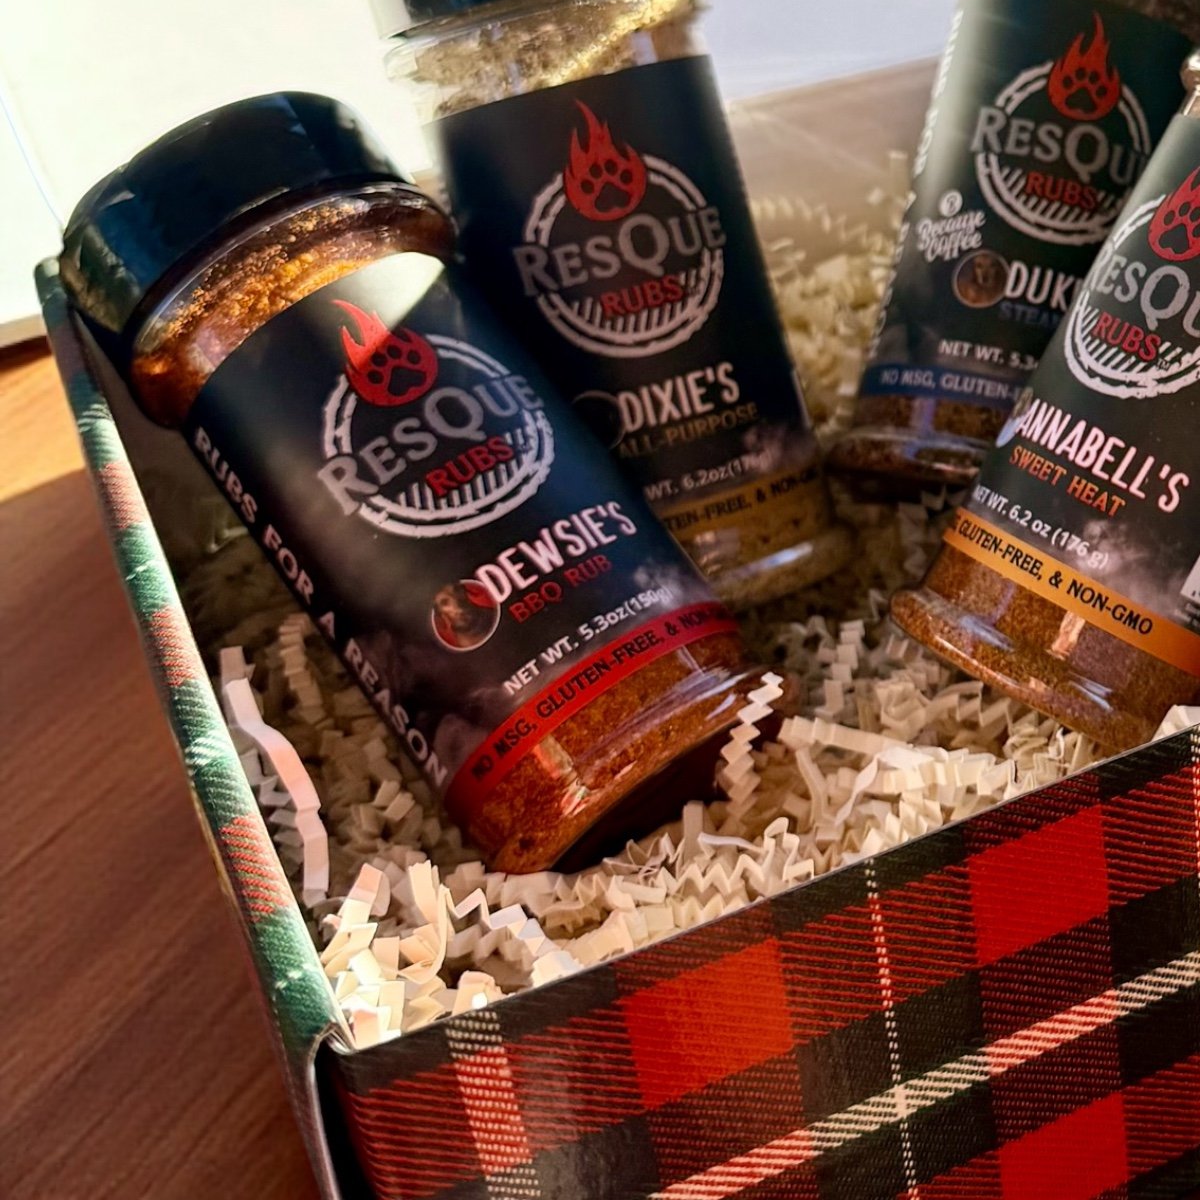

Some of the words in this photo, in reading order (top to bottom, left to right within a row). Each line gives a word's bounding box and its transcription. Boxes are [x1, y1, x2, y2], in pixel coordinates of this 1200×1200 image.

[971, 106, 1146, 185] RESQU
[1027, 171, 1099, 210] RUBS
[512, 206, 727, 298] RESQUE
[916, 209, 987, 249] Because
[600, 274, 685, 318] RUBS
[938, 339, 970, 357] NET
[975, 345, 1003, 363] WT.
[1091, 312, 1160, 360] RUBS
[617, 361, 741, 432] DIXIE'S
[619, 402, 759, 457] ALL-PURPOSE
[317, 375, 545, 516] RESQUE
[426, 436, 514, 498] RUBS
[1014, 398, 1190, 513] ANNABELL'S
[1009, 446, 1067, 486] SWEET
[1067, 476, 1126, 517] HEAT
[475, 501, 638, 604] DEWSIE'S
[987, 491, 1009, 516] WT.
[1009, 504, 1032, 527] 6.2
[1032, 520, 1051, 539] oz
[1051, 528, 1088, 557] (176
[1087, 551, 1109, 570] g)
[195, 426, 257, 523] RUBS
[263, 524, 314, 605] FOR
[318, 611, 336, 640] A
[345, 638, 449, 788] REASON
[508, 581, 564, 624] BBQ
[563, 555, 614, 588] RUB
[958, 519, 1042, 581] GLUTEN-FREE,
[1048, 571, 1063, 589] &
[1067, 579, 1153, 636] NON-GMO
[493, 717, 538, 758] MSG,
[536, 630, 666, 718] GLUTEN-FREE,
[664, 620, 680, 636] &
[503, 659, 541, 696] NET
[541, 635, 580, 665] WT.
